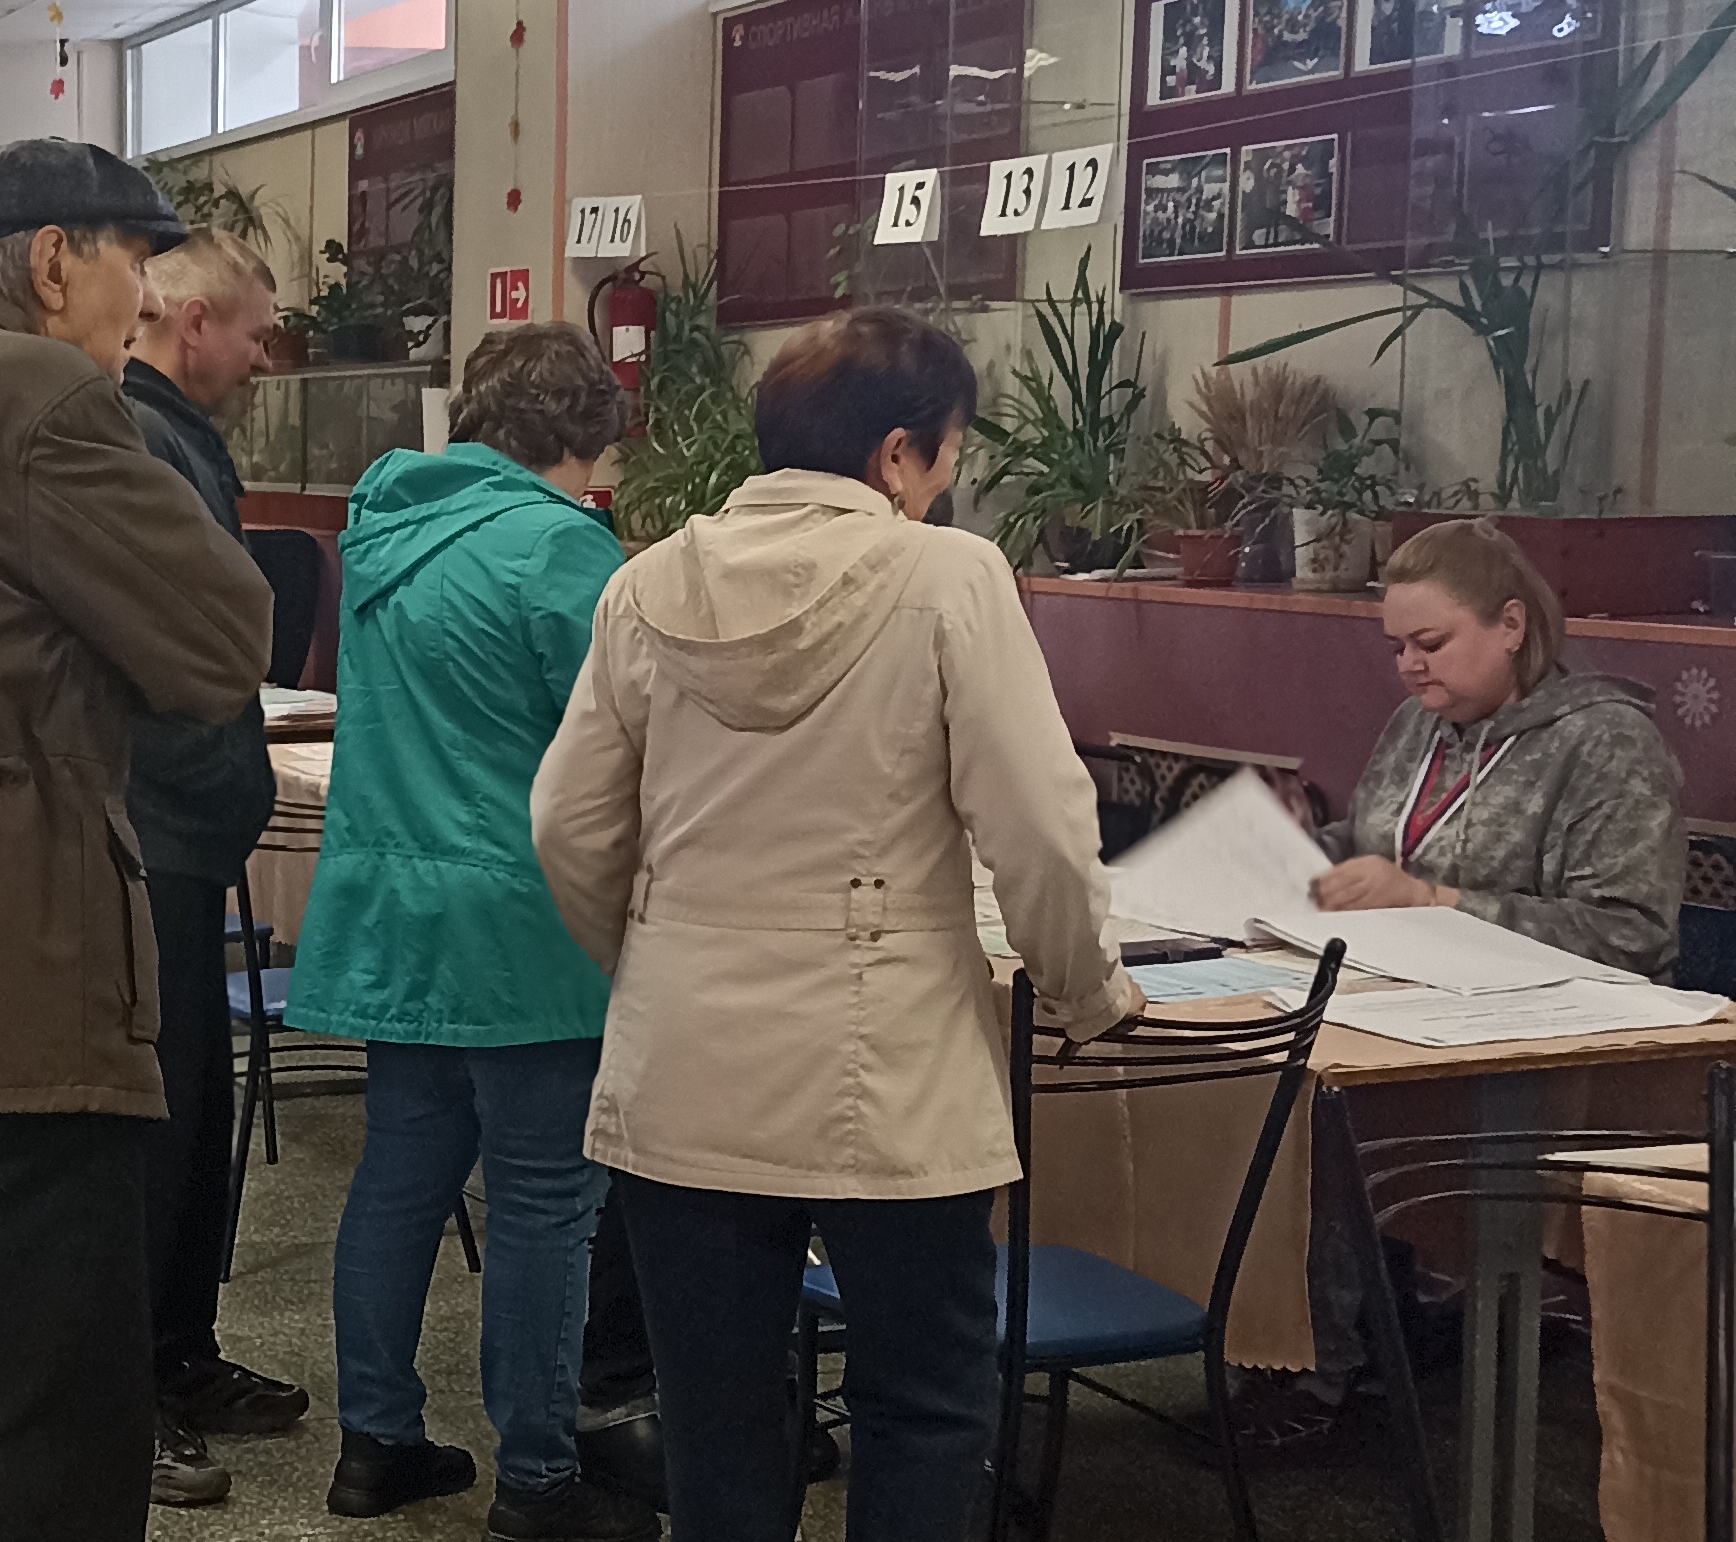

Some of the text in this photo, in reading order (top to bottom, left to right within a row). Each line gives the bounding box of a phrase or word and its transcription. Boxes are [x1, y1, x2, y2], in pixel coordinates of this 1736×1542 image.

[748, 4, 839, 50] СПОРТИВНАЯ
[891, 181, 926, 228] 15
[999, 166, 1034, 218] 13
[1061, 157, 1099, 211] 12
[575, 205, 600, 245] 17
[609, 204, 633, 244] 16
